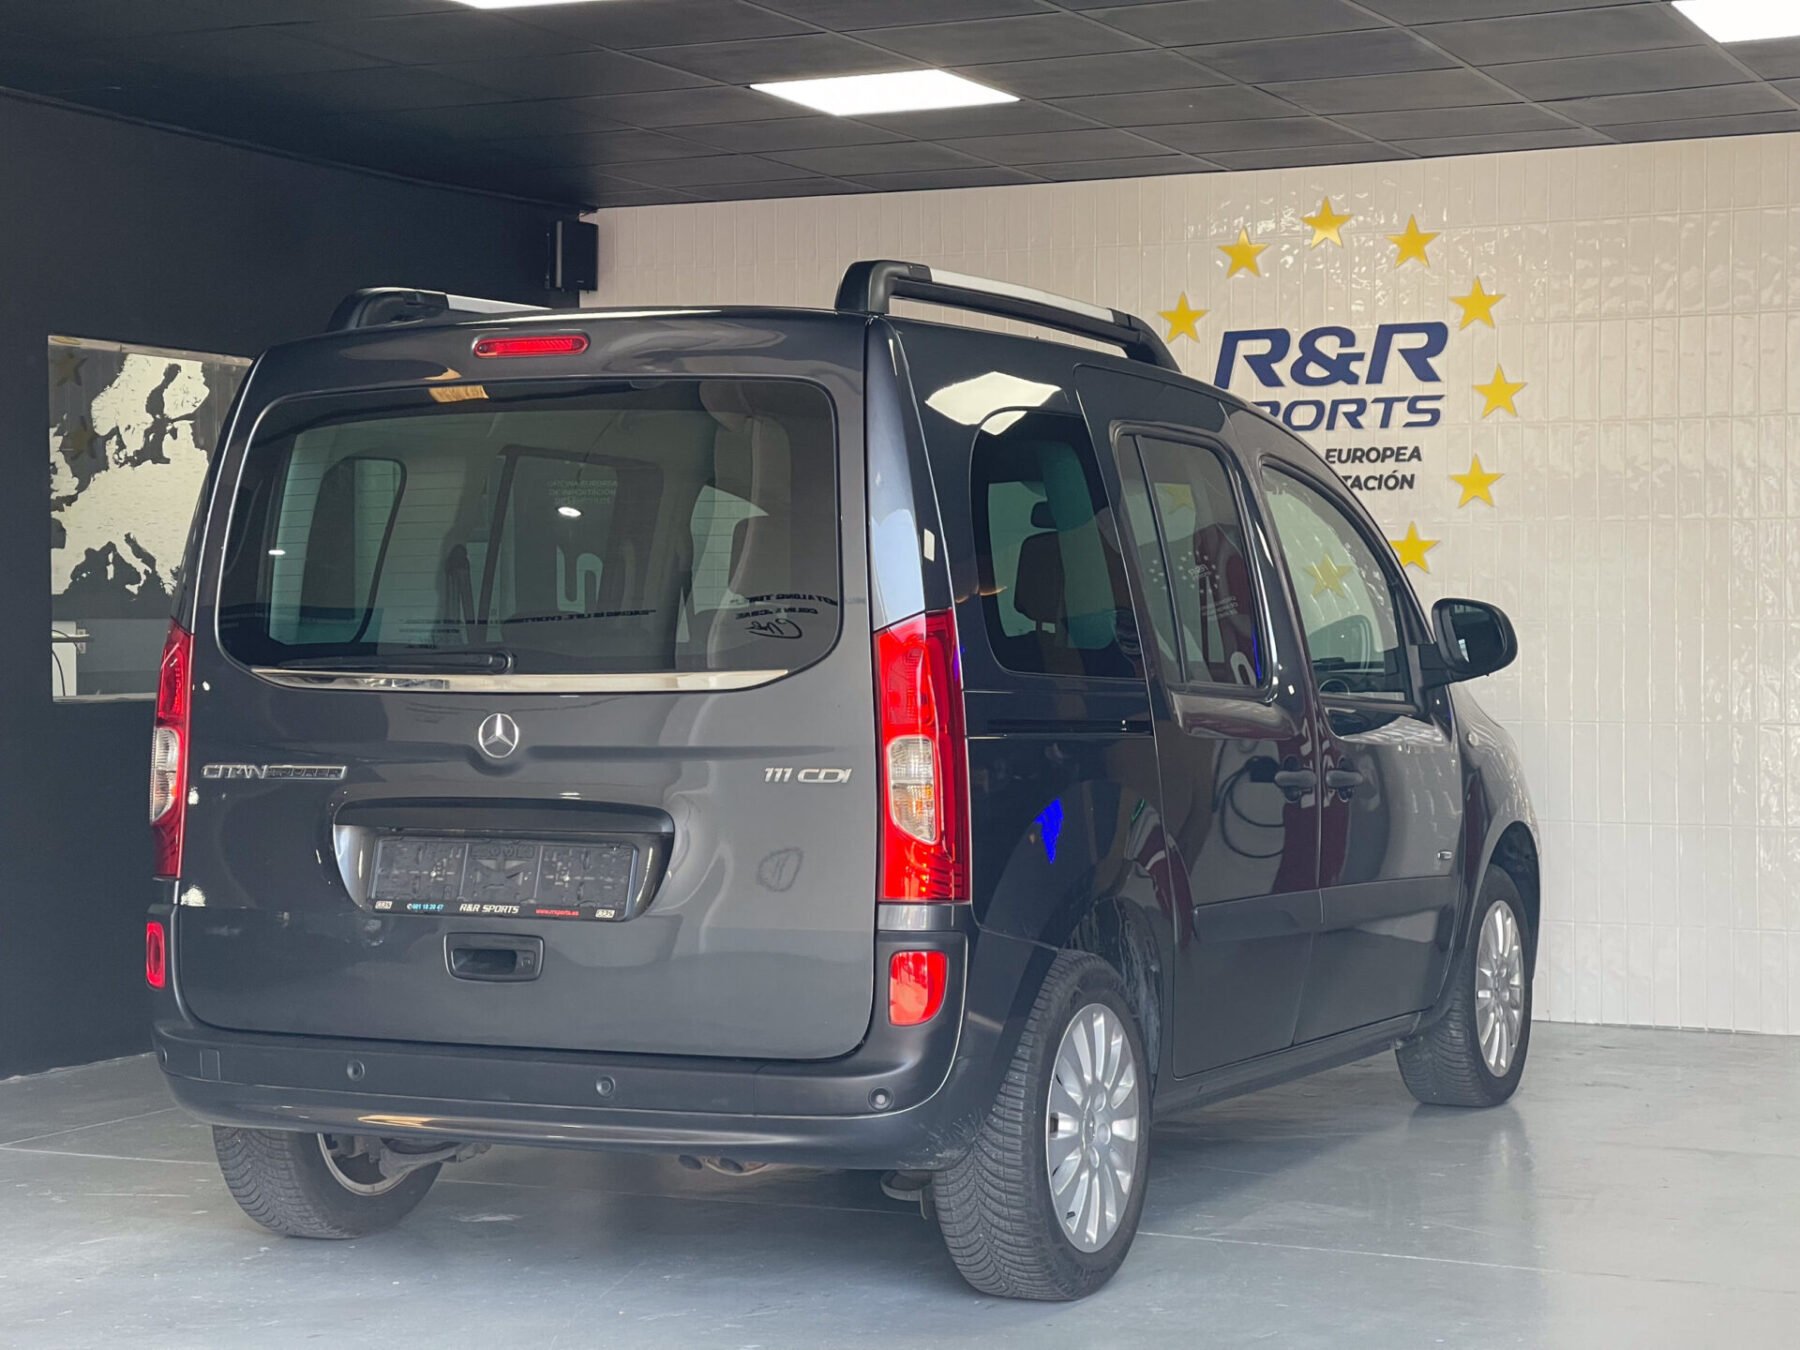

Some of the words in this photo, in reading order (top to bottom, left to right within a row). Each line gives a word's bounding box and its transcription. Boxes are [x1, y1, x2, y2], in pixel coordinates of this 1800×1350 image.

[1213, 322, 1449, 390] R&R
[1251, 394, 1445, 432] ORTS
[1325, 446, 1422, 464] EUROPEA
[764, 767, 793, 783] 111
[797, 768, 852, 783] CDI
[459, 903, 481, 912] R&R
[481, 904, 520, 914] SPORTS
